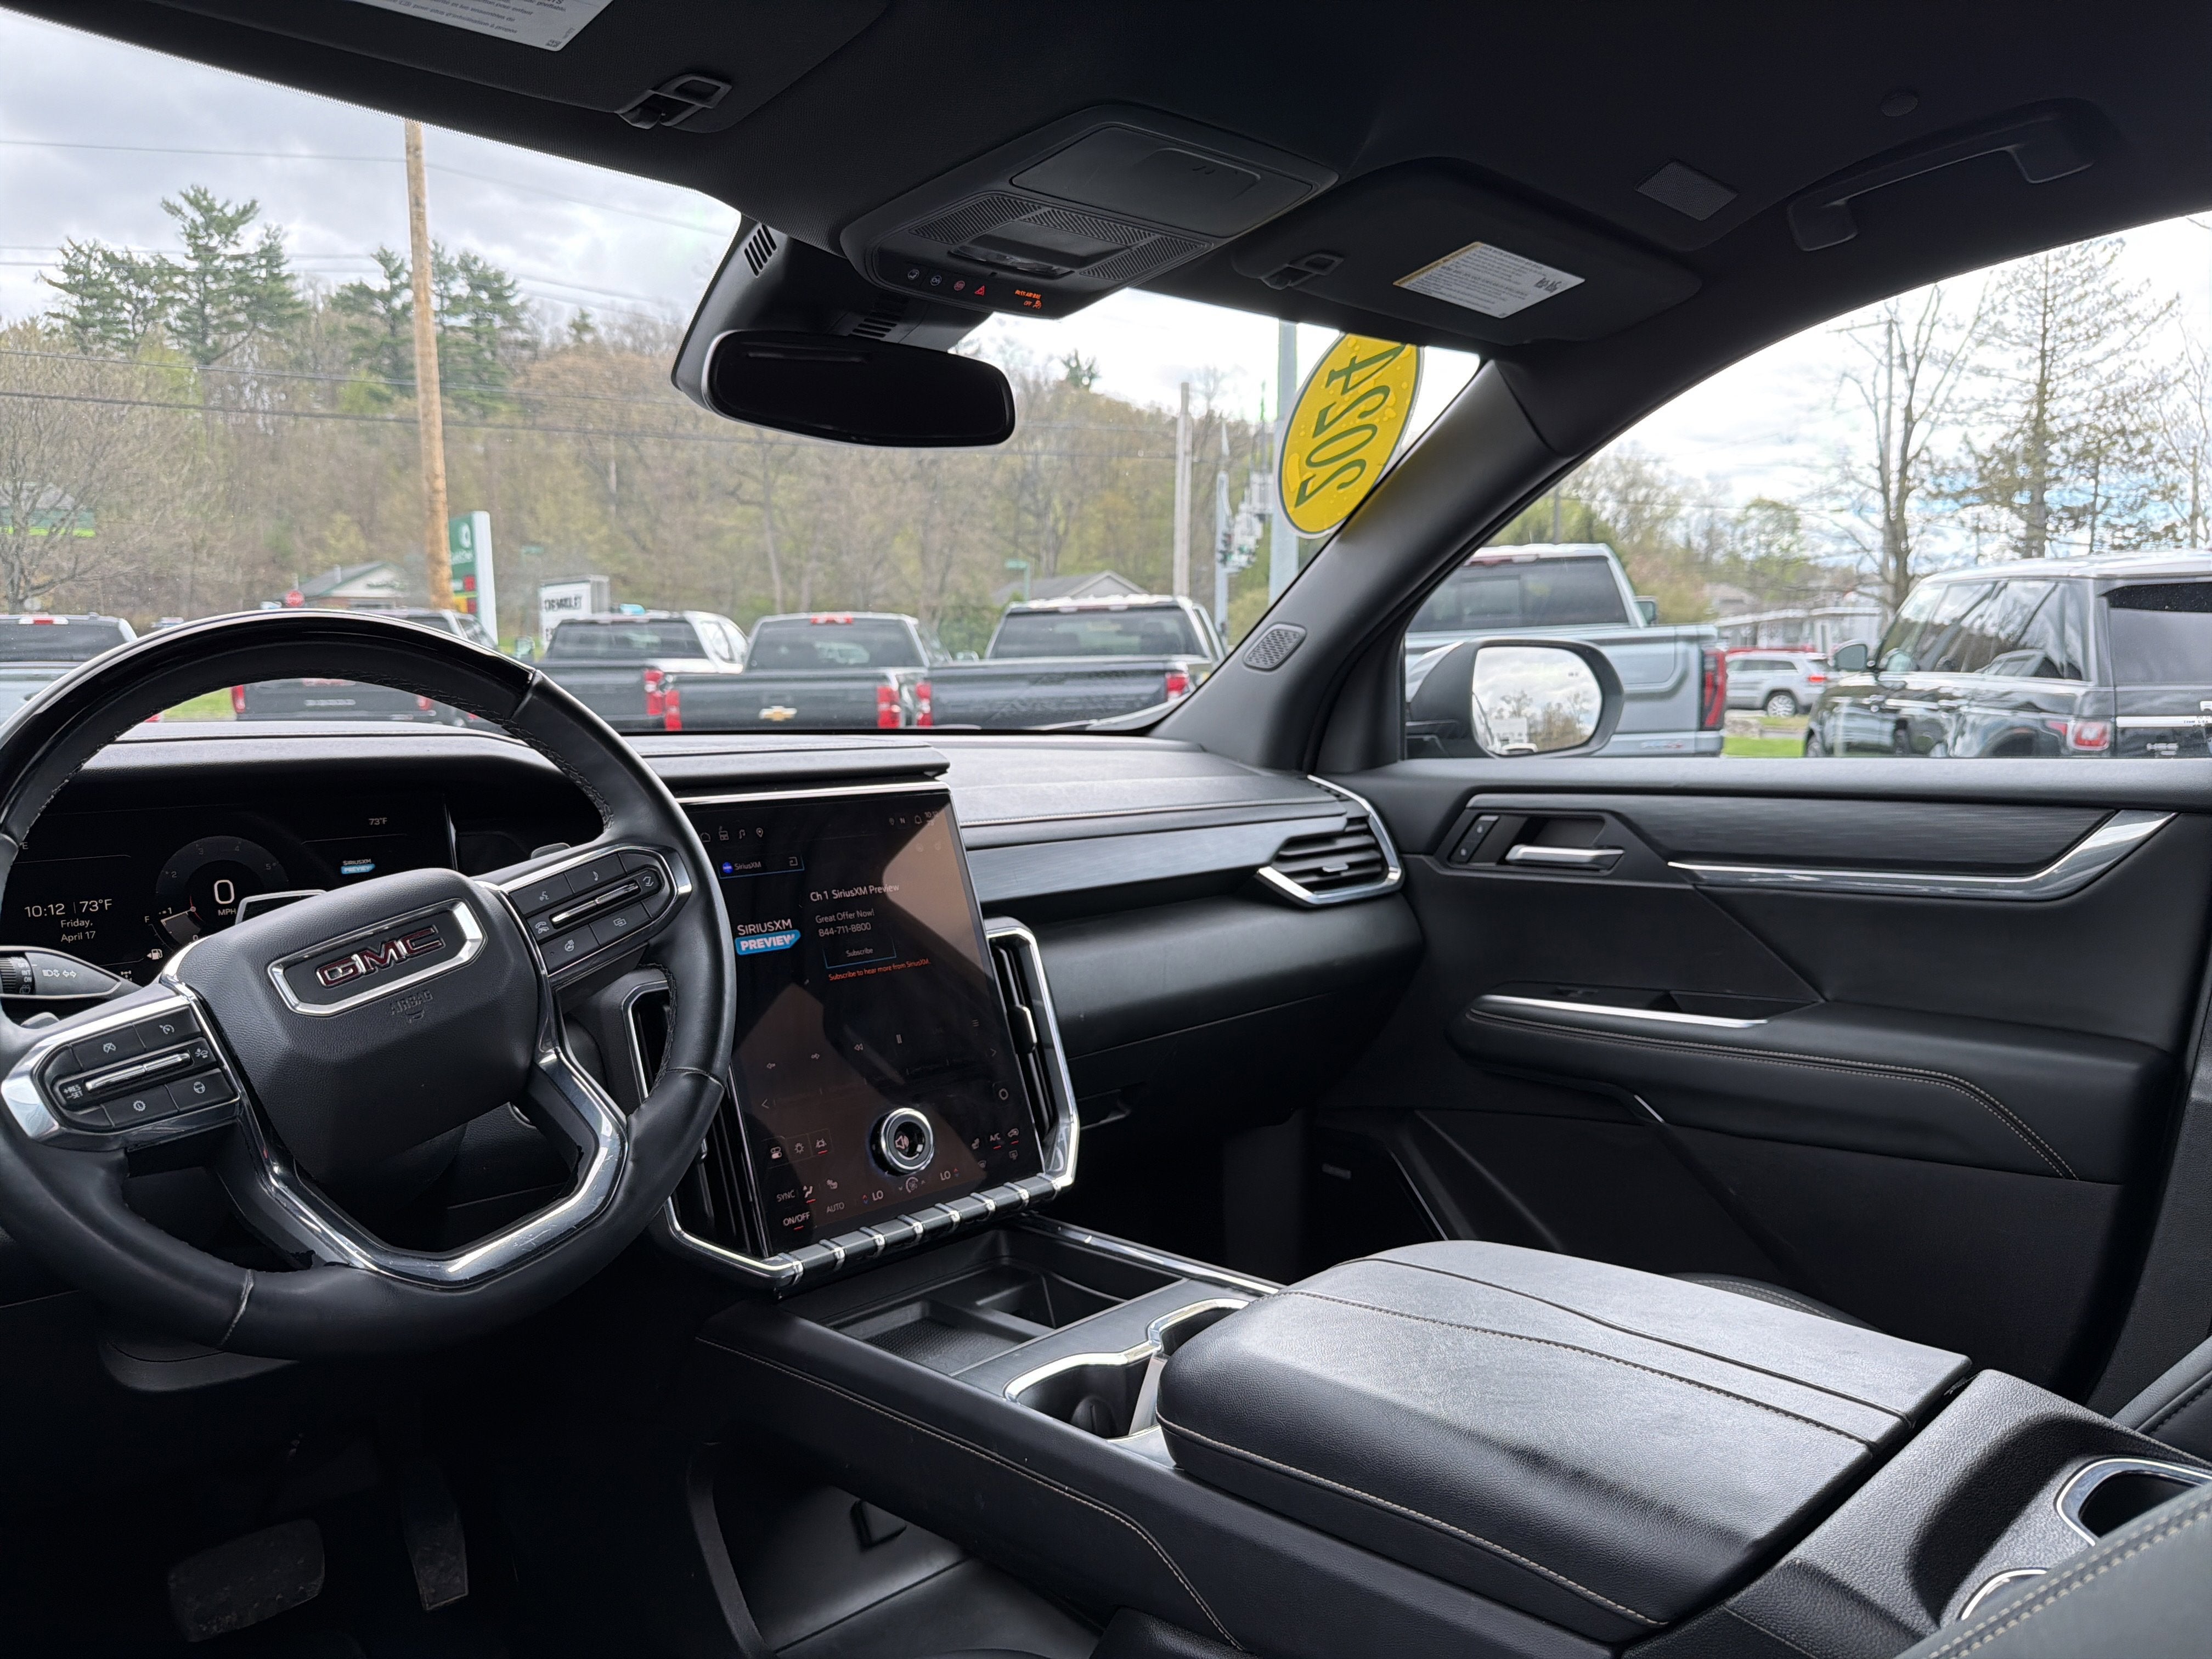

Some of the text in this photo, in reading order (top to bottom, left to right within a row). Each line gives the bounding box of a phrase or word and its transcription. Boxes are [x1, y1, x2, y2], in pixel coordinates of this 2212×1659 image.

[735, 861, 761, 870] SiriusXM
[214, 879, 235, 904] 0
[810, 884, 899, 901] Ch 1 SiriusXM Preview
[25, 899, 112, 917] 10:12 73°F
[61, 918, 93, 928] Friday,
[815, 909, 875, 924] Great Offer Now!
[737, 918, 793, 935] SIRIUSXM
[818, 922, 871, 937] 844-711-8800
[61, 931, 95, 944] April 17
[741, 934, 795, 951] PREVIEW
[316, 925, 445, 988] GMC
[845, 947, 873, 957] Subscribe
[828, 970, 856, 981] Subscribe
[390, 990, 433, 1015] AIRBAG
[990, 1133, 1001, 1141] A/C
[940, 1170, 951, 1181] LO
[776, 1189, 795, 1202] SYNC
[872, 1190, 883, 1201] LO
[826, 1202, 844, 1213] AUTO
[783, 1211, 810, 1226] ON/OFF
